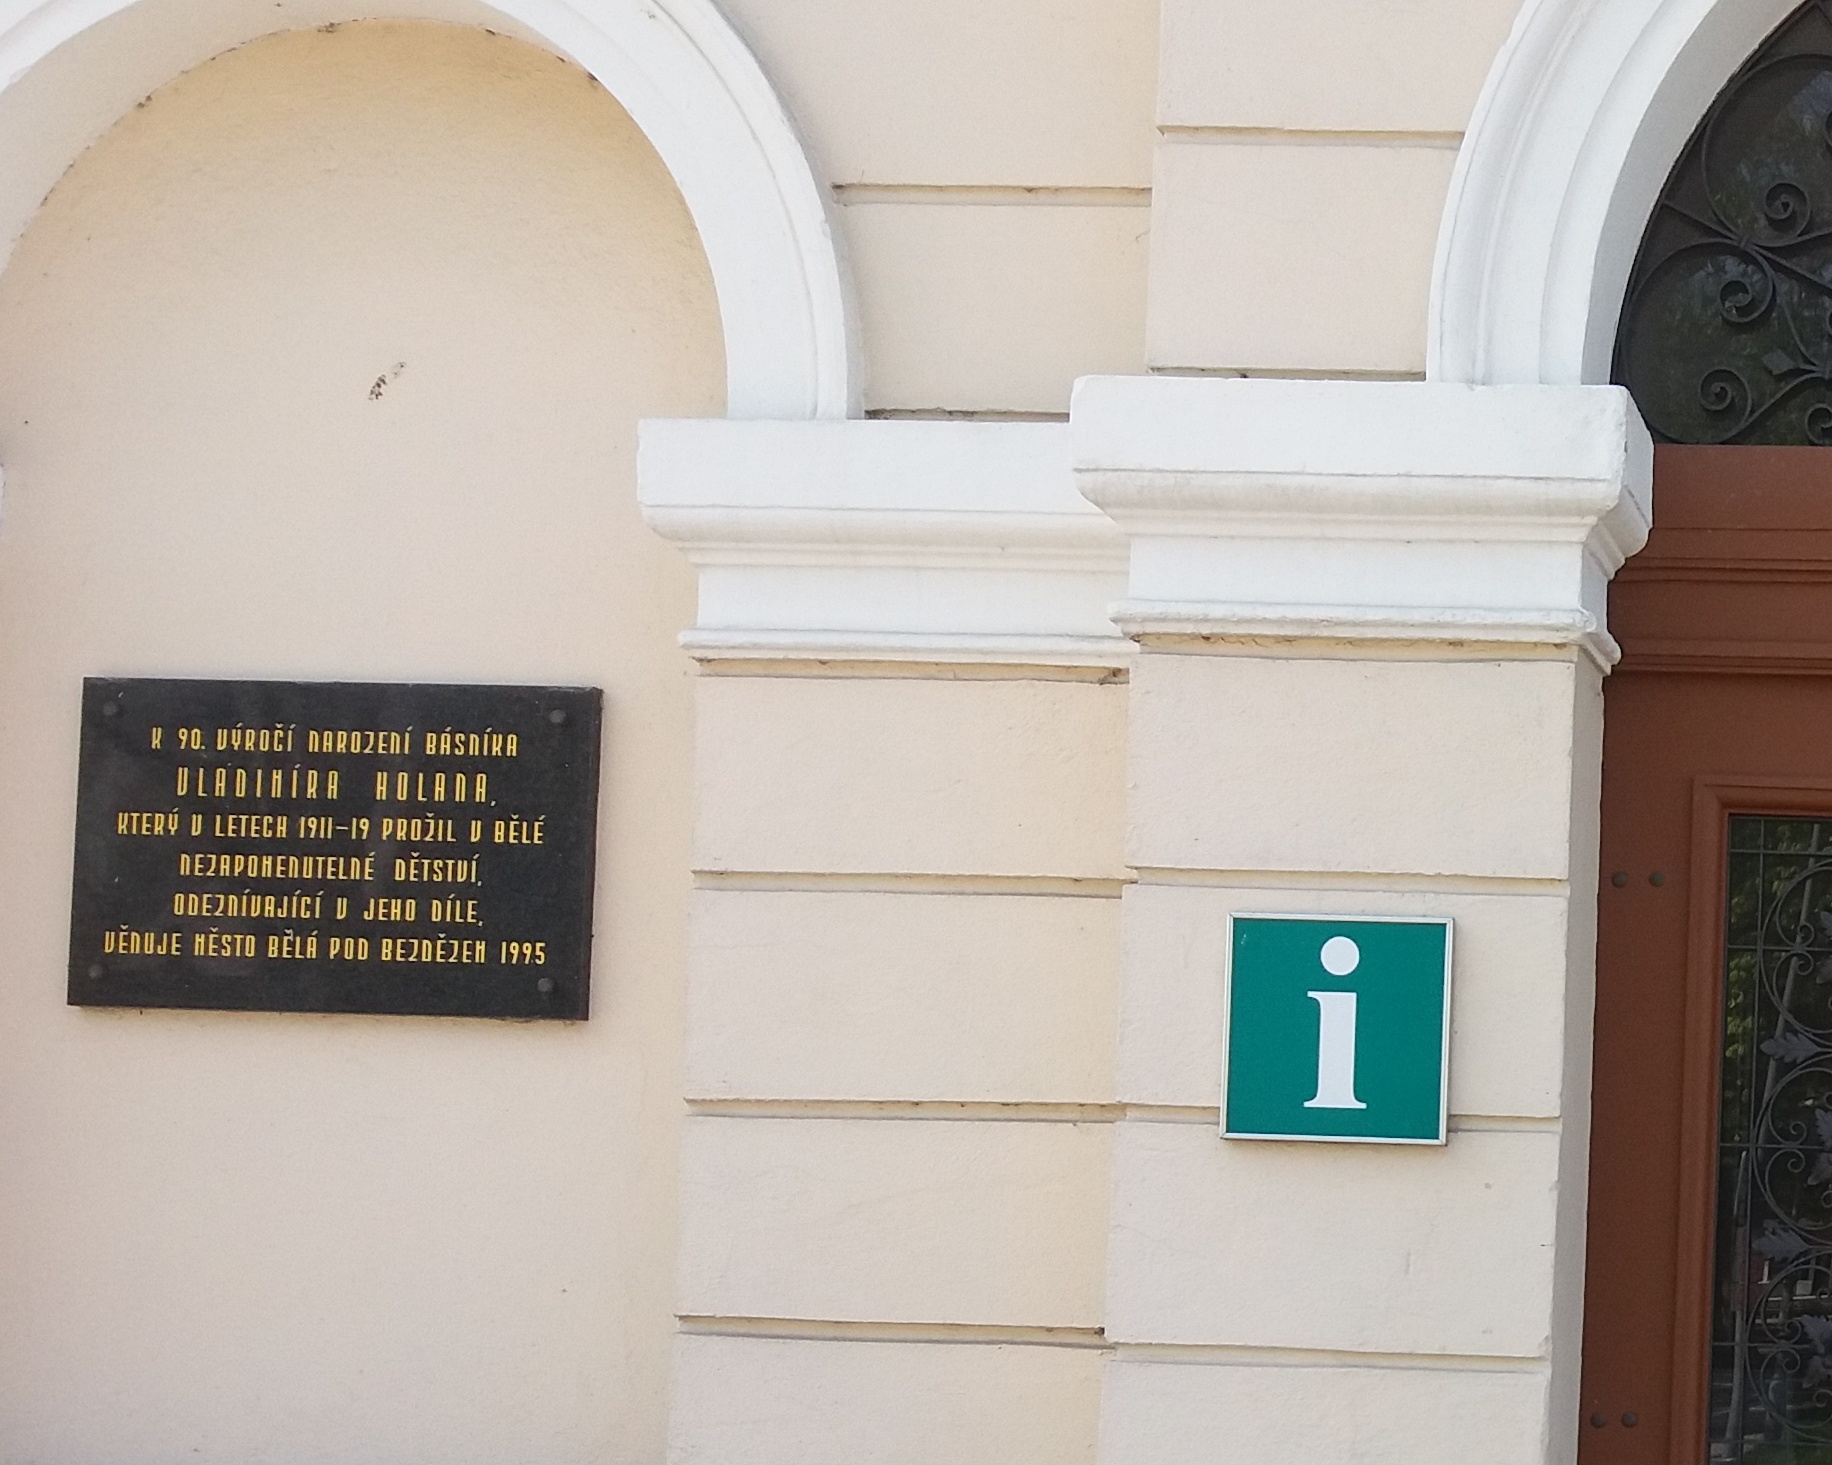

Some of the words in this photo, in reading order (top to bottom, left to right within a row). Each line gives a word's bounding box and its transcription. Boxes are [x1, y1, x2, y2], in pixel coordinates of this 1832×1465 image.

[150, 727, 162, 751] K
[178, 728, 205, 751] 90.
[216, 723, 294, 753] VÝROČÍ
[307, 725, 412, 756] NAROZENÍ
[425, 728, 519, 757] BÁSNÍKA
[175, 763, 339, 801] VLADIMÍRA
[375, 771, 498, 806] HOLANA,
[116, 811, 179, 837] KTERÝ
[191, 814, 203, 838] V
[214, 815, 288, 839] LETECH
[381, 813, 457, 842] PROŽIL
[469, 820, 482, 843] V
[493, 814, 546, 844] BĚLÉ
[179, 852, 375, 880] NEZAPOMENUTELNÉ
[394, 851, 483, 886] DĚTSTVÍ,
[172, 890, 323, 919] ODEZNÍVAJÍCÍ
[336, 897, 348, 920] V
[363, 897, 417, 923] JEHO
[430, 894, 484, 926] DÍLE,
[103, 925, 182, 956] VĚNUJE
[193, 928, 256, 958] MĚSTO
[266, 929, 319, 959] BĚLÁ
[328, 937, 370, 960] POD
[380, 933, 486, 963] BEZDĚZEM
[500, 942, 546, 965] 1995
